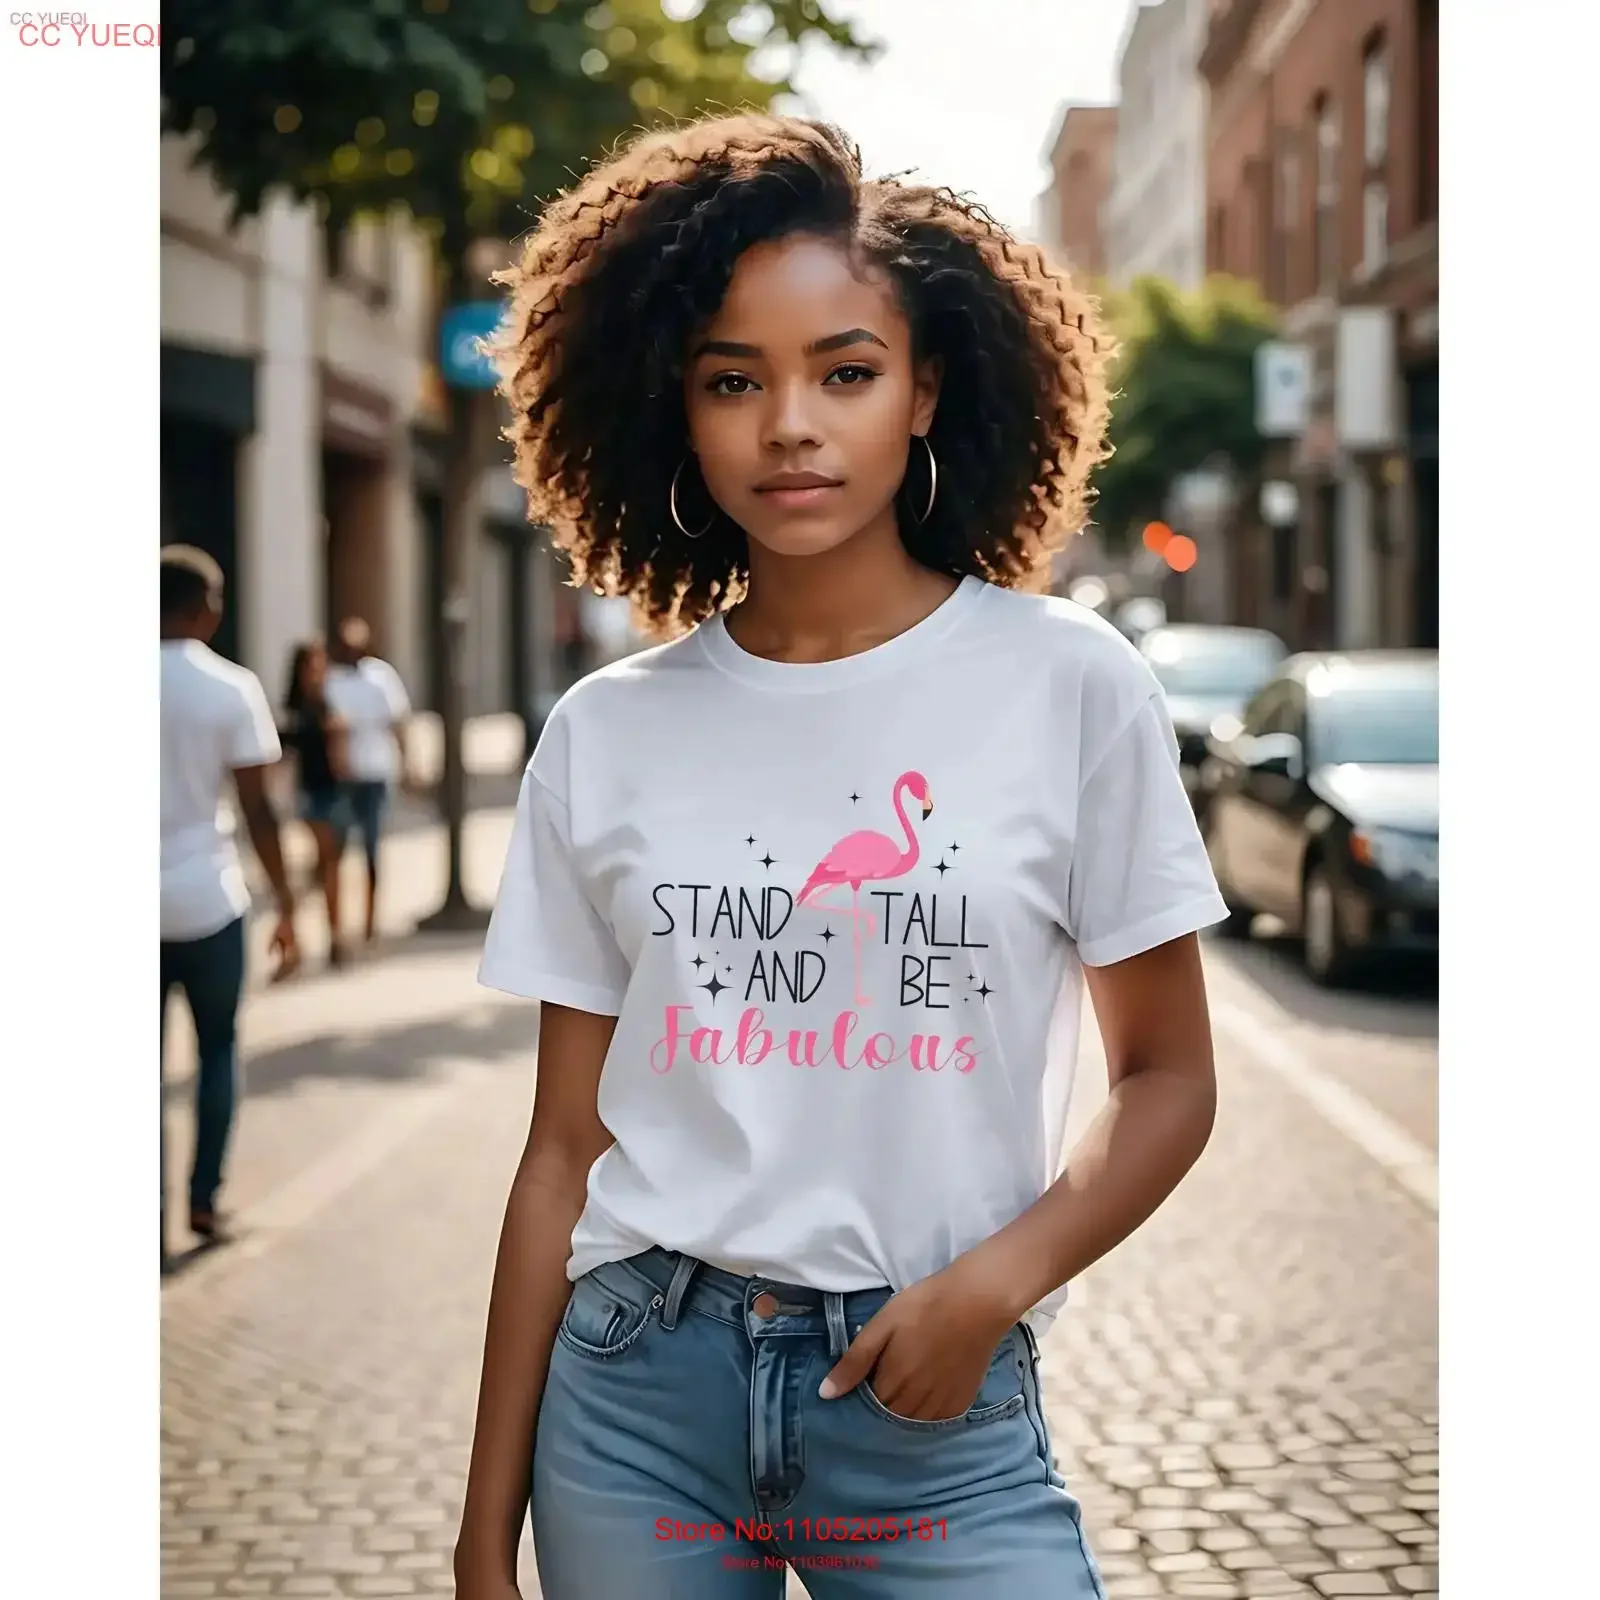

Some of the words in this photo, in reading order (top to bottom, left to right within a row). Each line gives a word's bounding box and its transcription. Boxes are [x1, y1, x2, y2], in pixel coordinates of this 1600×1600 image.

[652, 883, 794, 941] STAND
[870, 890, 989, 948] TALL
[744, 949, 826, 1004] AND
[900, 954, 952, 1009] BE
[649, 1005, 984, 1075] Fabulous
